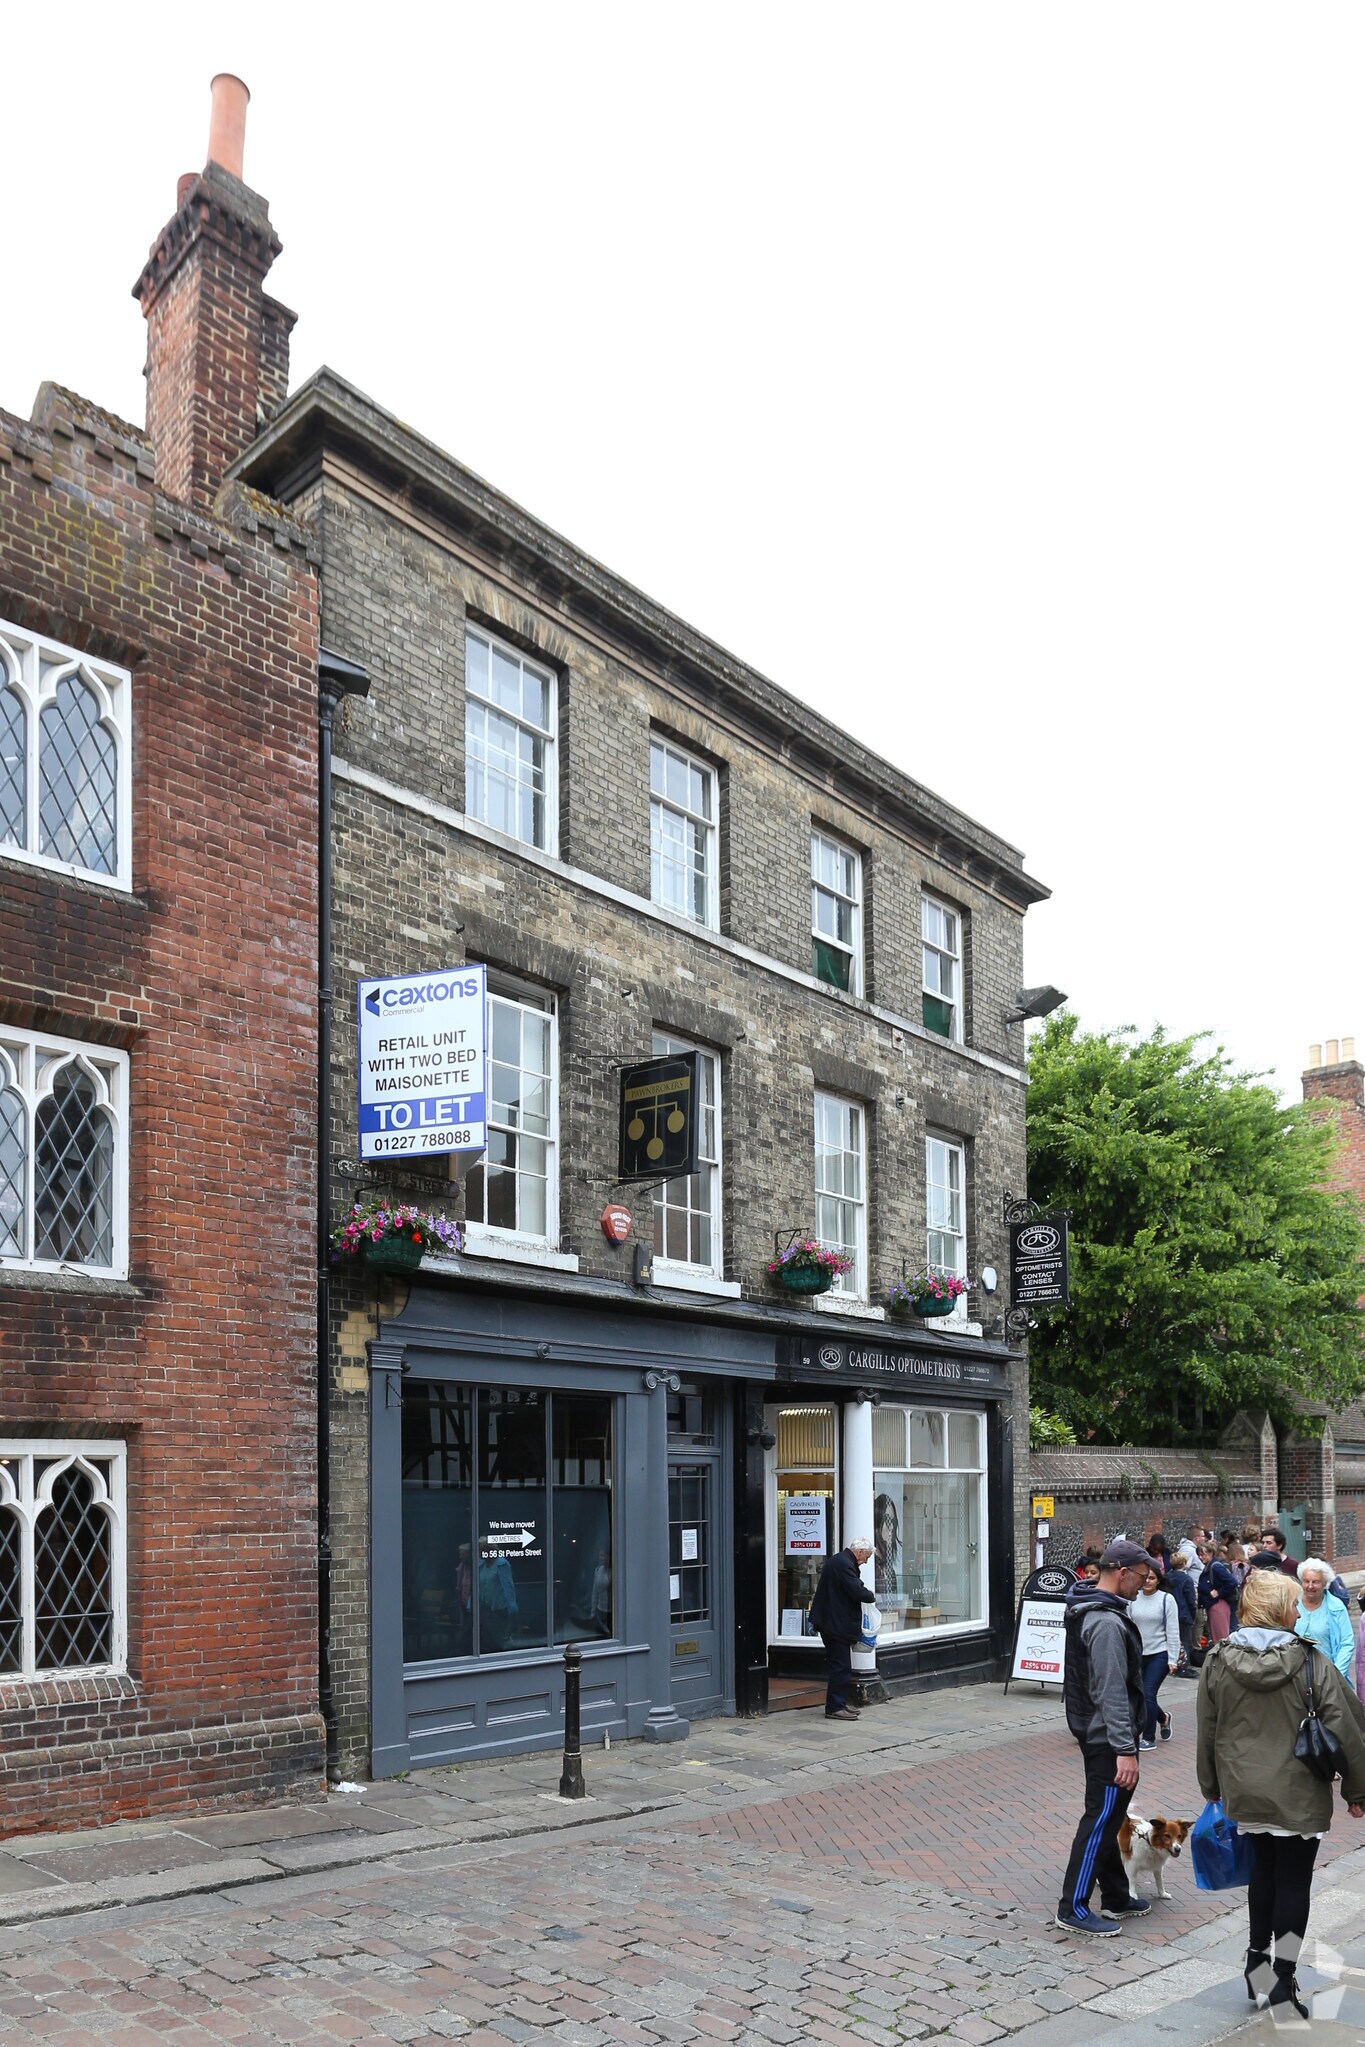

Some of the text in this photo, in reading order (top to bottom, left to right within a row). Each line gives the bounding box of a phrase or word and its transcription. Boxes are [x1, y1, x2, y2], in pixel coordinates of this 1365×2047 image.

[382, 978, 478, 1007] caxtons
[382, 1006, 425, 1017] Commercial
[378, 1030, 466, 1052] RETAIL UNIT
[368, 1049, 477, 1072] WITH TWO BED
[375, 1069, 470, 1091] MAISONETTE
[631, 1080, 683, 1098] PAWNBROKERS
[373, 1096, 471, 1130] TO LET
[374, 1130, 471, 1151] 01227 788088
[1015, 1262, 1063, 1273] OPTOMETRISTS
[1022, 1271, 1056, 1280] CONTACT
[1024, 1278, 1053, 1286] LENSES
[1019, 1290, 1037, 1298] 01227
[802, 1357, 811, 1365] 59
[848, 1350, 896, 1372] CARGILLS
[898, 1356, 961, 1379] OPTOMETRISTS
[489, 1520, 535, 1529] We have moved
[489, 1550, 497, 1558] 56
[505, 1549, 524, 1557] Peters
[525, 1548, 542, 1556] Street
[1028, 1608, 1065, 1617] CALVIN KLEI
[1050, 1620, 1065, 1628] SALE
[1024, 1661, 1056, 1671] 25% OFF
